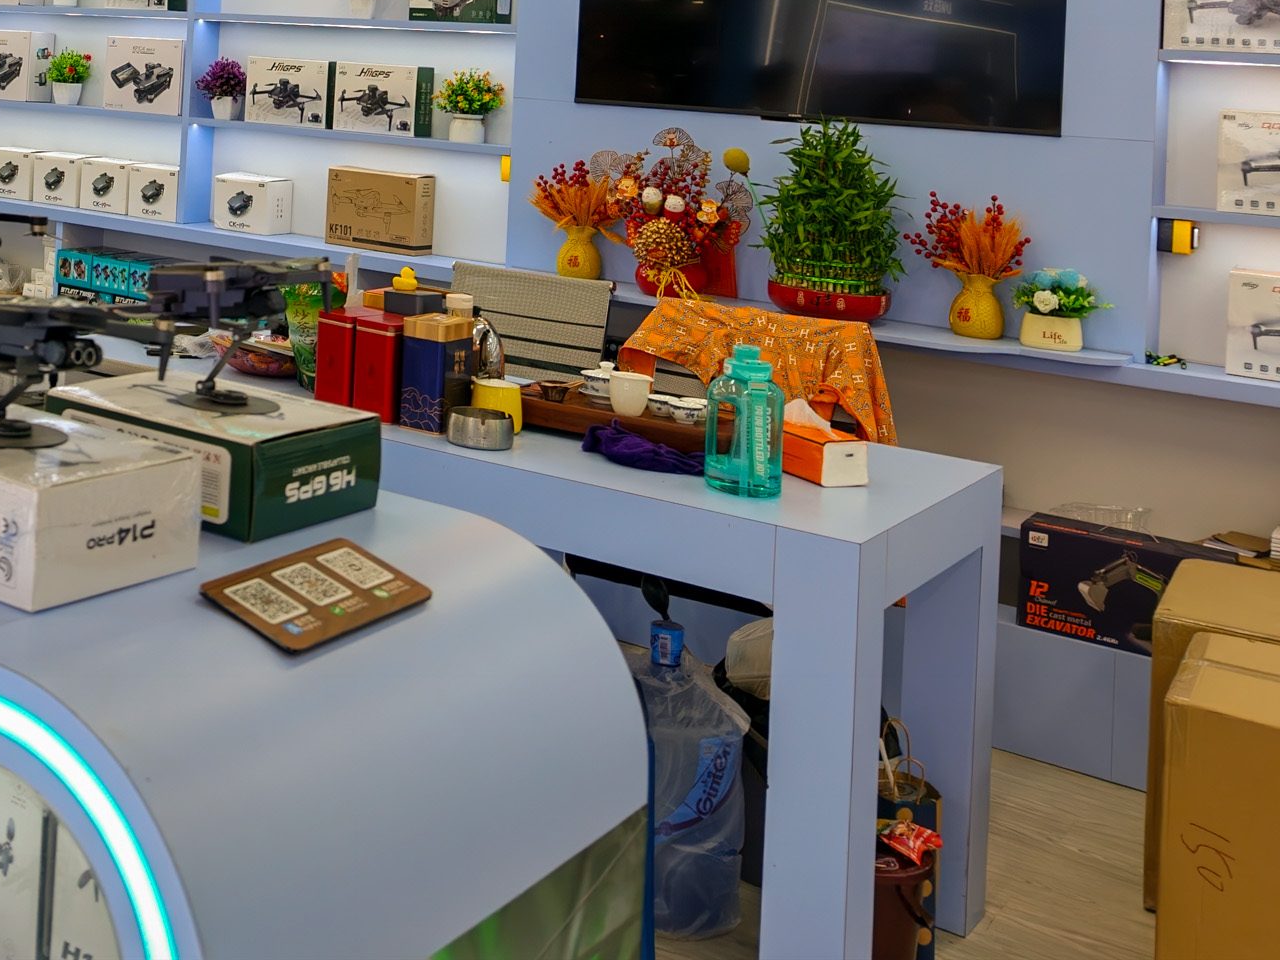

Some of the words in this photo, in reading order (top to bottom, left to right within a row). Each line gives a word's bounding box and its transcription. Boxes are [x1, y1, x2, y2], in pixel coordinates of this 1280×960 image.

[329, 223, 352, 236] KF101
[567, 255, 580, 269] 福
[956, 307, 971, 324] 福
[1042, 330, 1062, 340] Life
[328, 466, 356, 493] H6
[284, 474, 327, 505] GPS
[1029, 580, 1049, 598] 12
[1026, 602, 1048, 617] DIE
[1067, 616, 1092, 626] metal
[1026, 614, 1096, 639] EXCAVATOR
